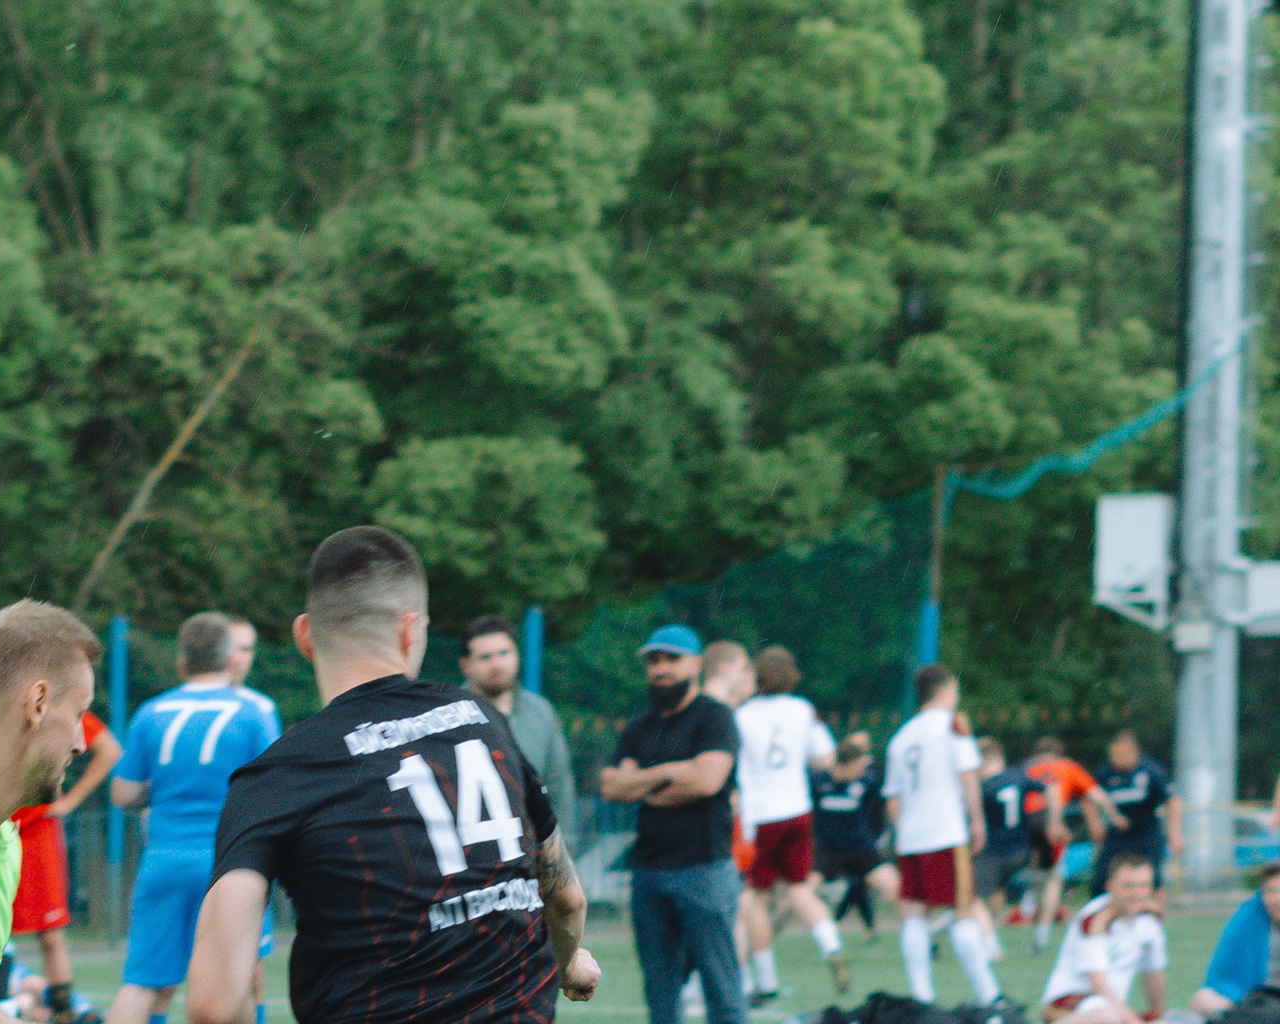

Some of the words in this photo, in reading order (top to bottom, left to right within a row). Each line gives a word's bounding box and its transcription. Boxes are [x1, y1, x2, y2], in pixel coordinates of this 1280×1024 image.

[153, 700, 241, 766] 77
[766, 724, 788, 770] 6
[385, 739, 526, 877] 14
[996, 784, 1019, 830] 1
